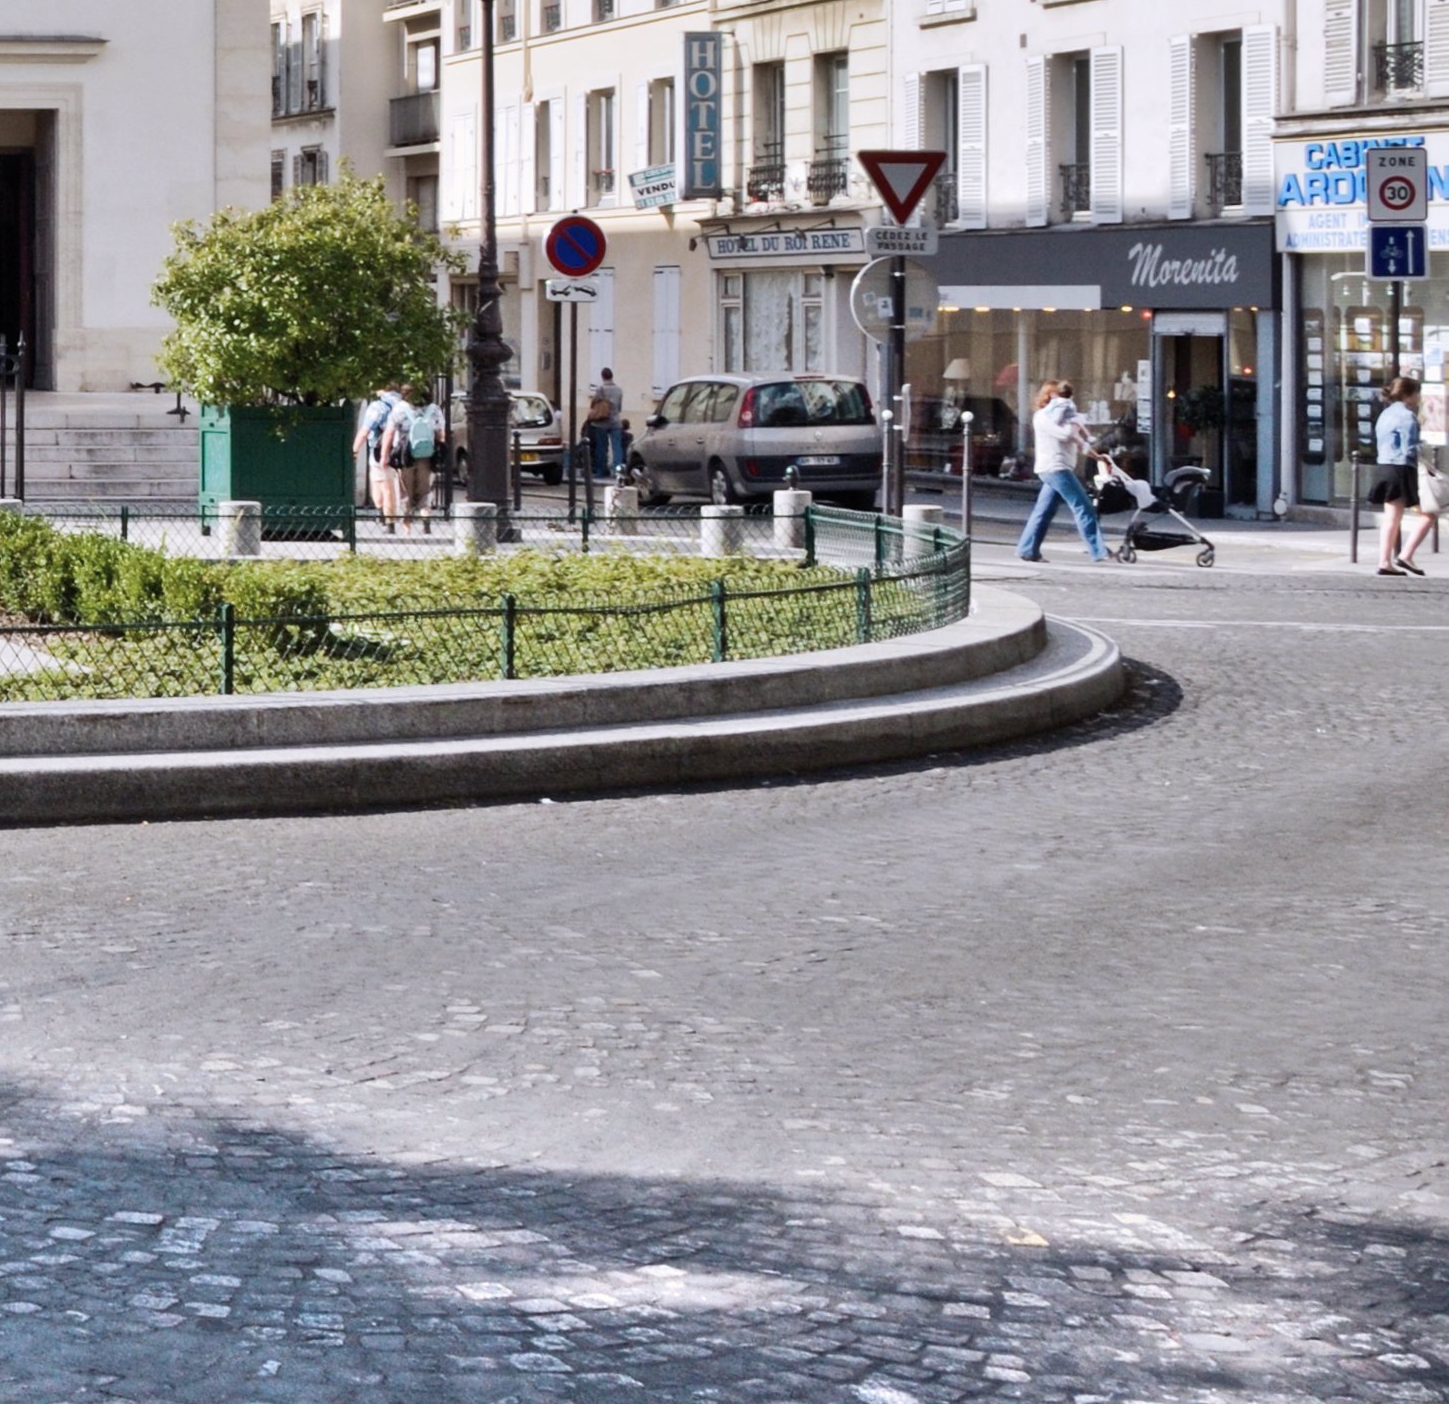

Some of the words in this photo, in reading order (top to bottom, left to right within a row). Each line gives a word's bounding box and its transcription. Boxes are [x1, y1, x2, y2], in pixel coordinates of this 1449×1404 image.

[689, 40, 717, 189] HOTEL
[1304, 136, 1425, 170] CABI
[1378, 156, 1416, 167] ZONE
[1386, 186, 1409, 201] 30
[1308, 212, 1348, 229] AGENT
[761, 237, 780, 252] DU
[784, 235, 808, 251] ROI
[915, 232, 928, 241] LE
[1285, 231, 1368, 248] ADMINISTRATE
[876, 242, 926, 252] PASSAGE
[1128, 242, 1239, 288] Morenita
